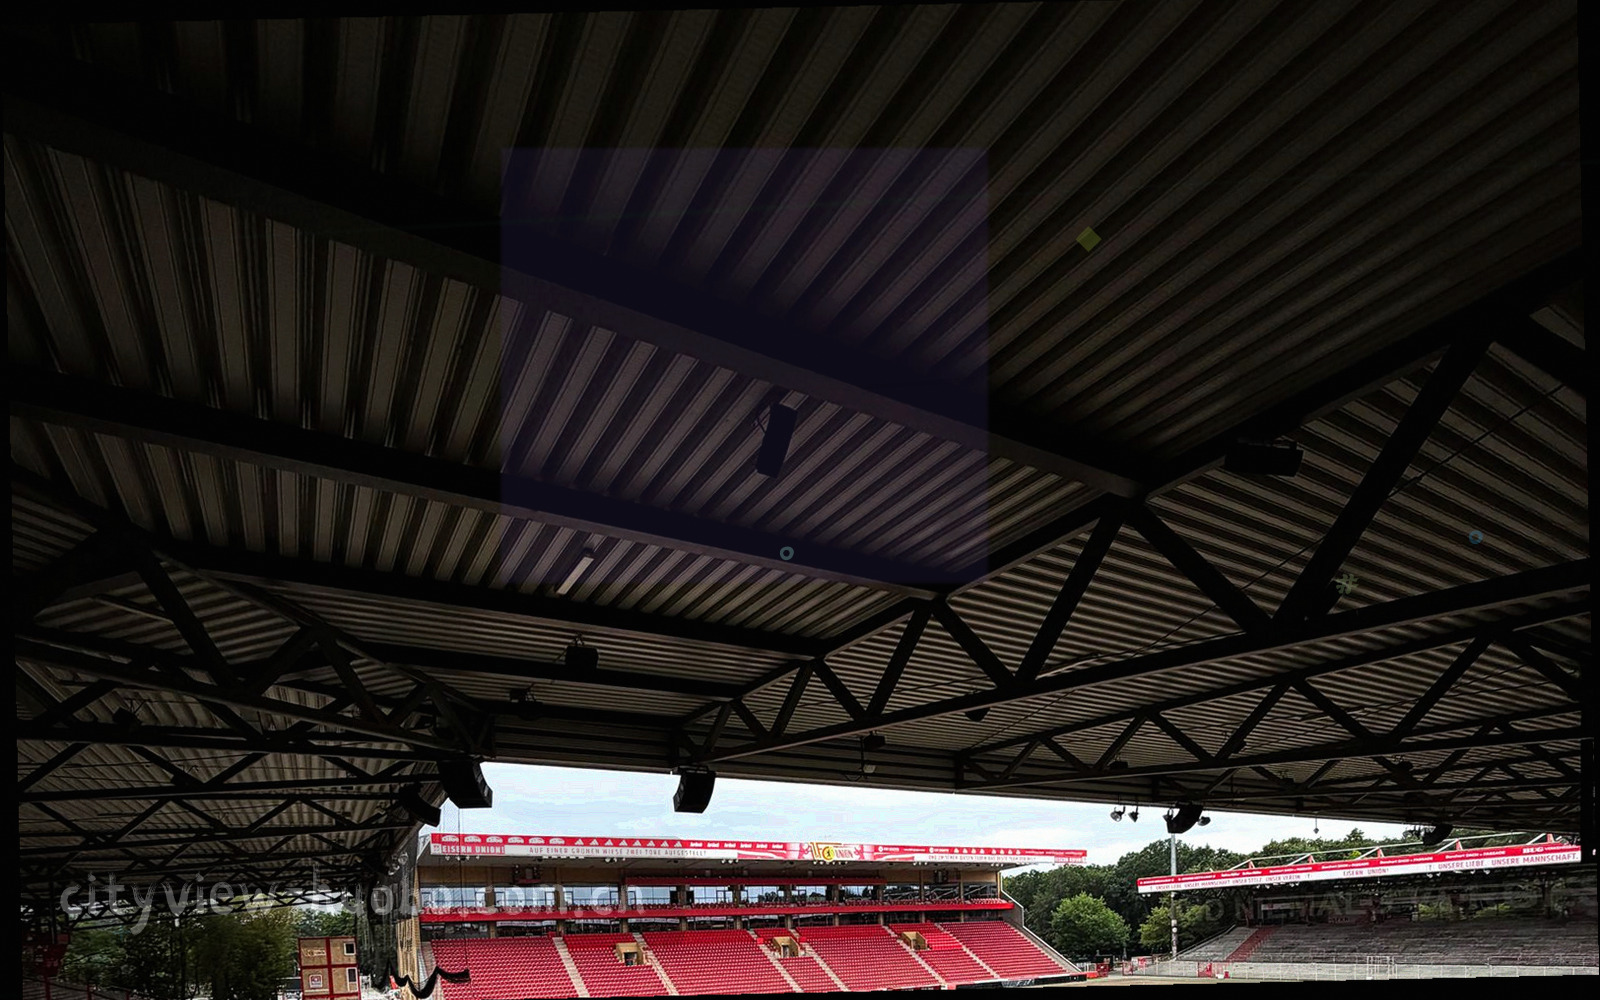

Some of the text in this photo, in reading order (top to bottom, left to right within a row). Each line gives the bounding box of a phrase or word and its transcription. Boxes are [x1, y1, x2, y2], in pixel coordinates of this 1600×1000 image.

[442, 845, 505, 854] EISERN UNION!
[1438, 861, 1464, 870] UNSERE
[1491, 857, 1520, 866] UNSERE
